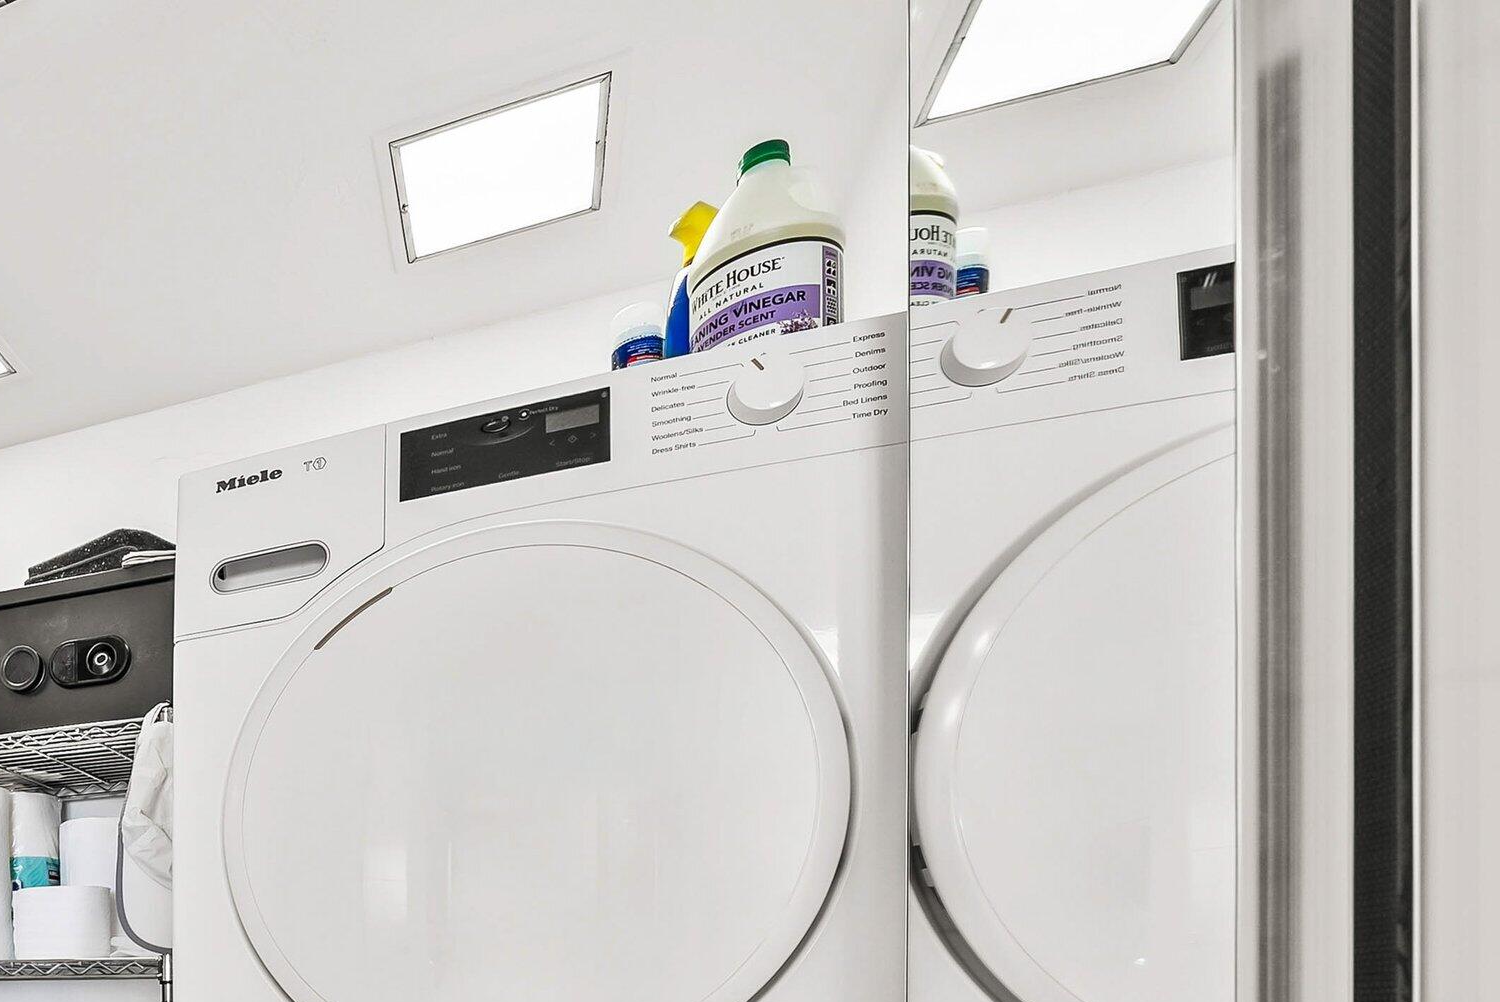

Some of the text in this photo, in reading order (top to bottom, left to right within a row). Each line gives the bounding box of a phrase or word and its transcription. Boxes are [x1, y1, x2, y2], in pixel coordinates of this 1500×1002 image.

[692, 257, 782, 315] WHITE HOUSE
[699, 282, 764, 321] ALL NATURAL
[732, 290, 806, 318] VINEGAR
[696, 310, 776, 353] AVENDER SCENT
[738, 328, 776, 345] CLEANER
[853, 332, 885, 342] Express
[855, 348, 886, 358] Denims
[853, 363, 886, 374] Outdoor
[651, 373, 677, 383] Normal
[854, 380, 887, 390] Proofing
[651, 385, 695, 397] Wrinkle-free
[861, 394, 888, 403] Linens
[651, 402, 685, 412] Delicates
[652, 416, 692, 427] Smoothing
[431, 432, 447, 440] Extra
[652, 428, 703, 441] Woolens/Silks
[431, 448, 454, 457] Normal
[652, 442, 696, 454] Dress Shirts
[431, 464, 462, 474] Hand iron
[216, 469, 282, 493] Miele
